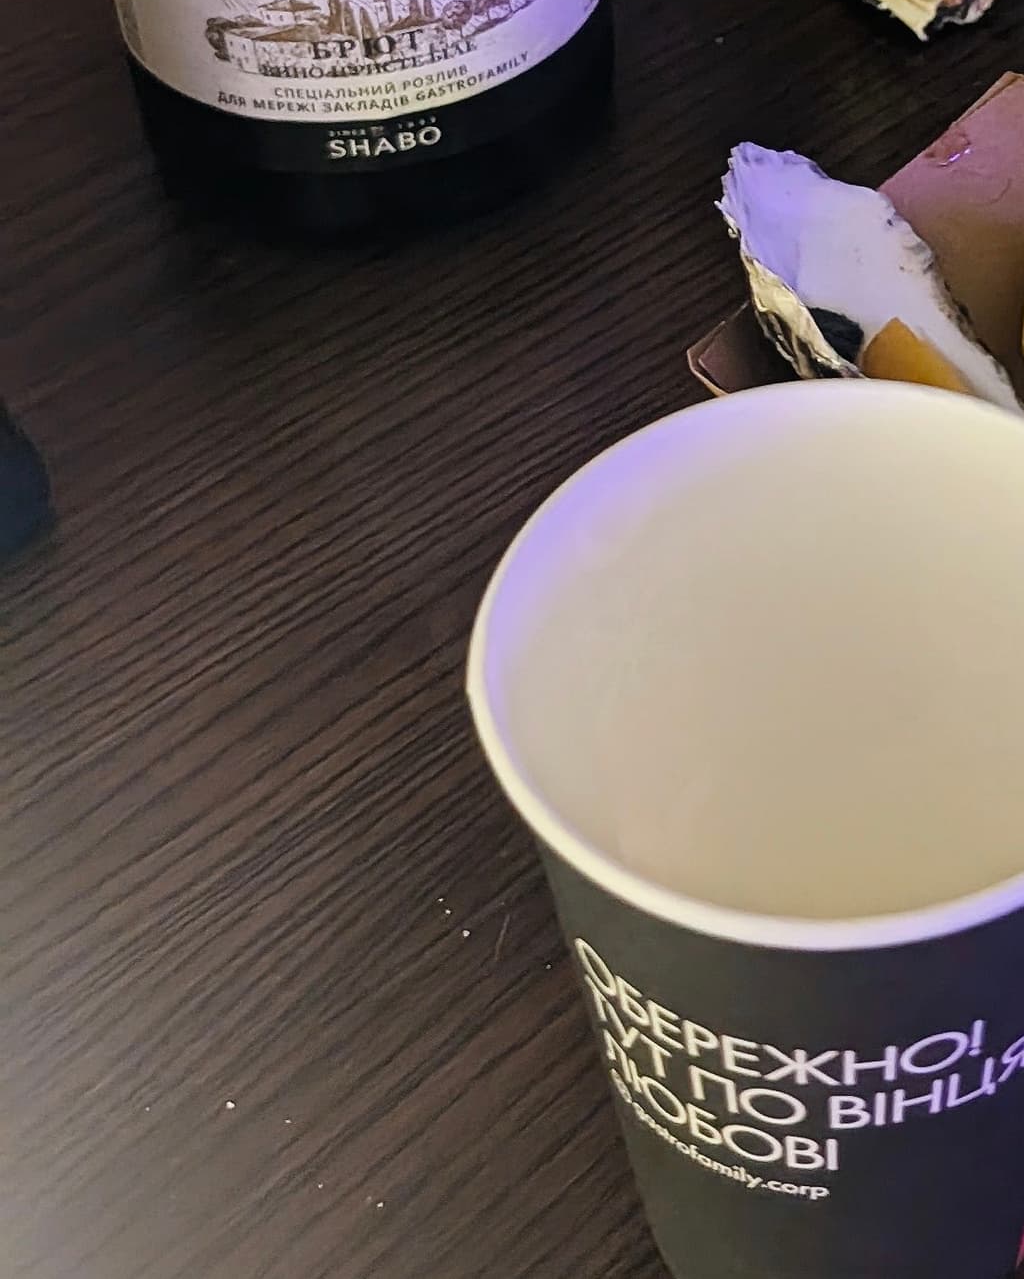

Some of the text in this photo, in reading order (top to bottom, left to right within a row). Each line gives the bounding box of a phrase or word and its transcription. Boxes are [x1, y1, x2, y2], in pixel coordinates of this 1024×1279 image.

[311, 28, 425, 60] БРЮТ
[217, 51, 530, 113] ДЛЯ МЕРЕЖІ ЗАКЛАДІВ GASTROFAMILY
[274, 64, 469, 100] СПЕЦІАЛЬНИЙ РОЗЛИВ
[328, 126, 443, 160] SHABO
[574, 937, 986, 1087] ОБЕРЕЖНО!
[603, 1029, 839, 1171] ЛЮБОВІ
[689, 1065, 807, 1125] ПО
